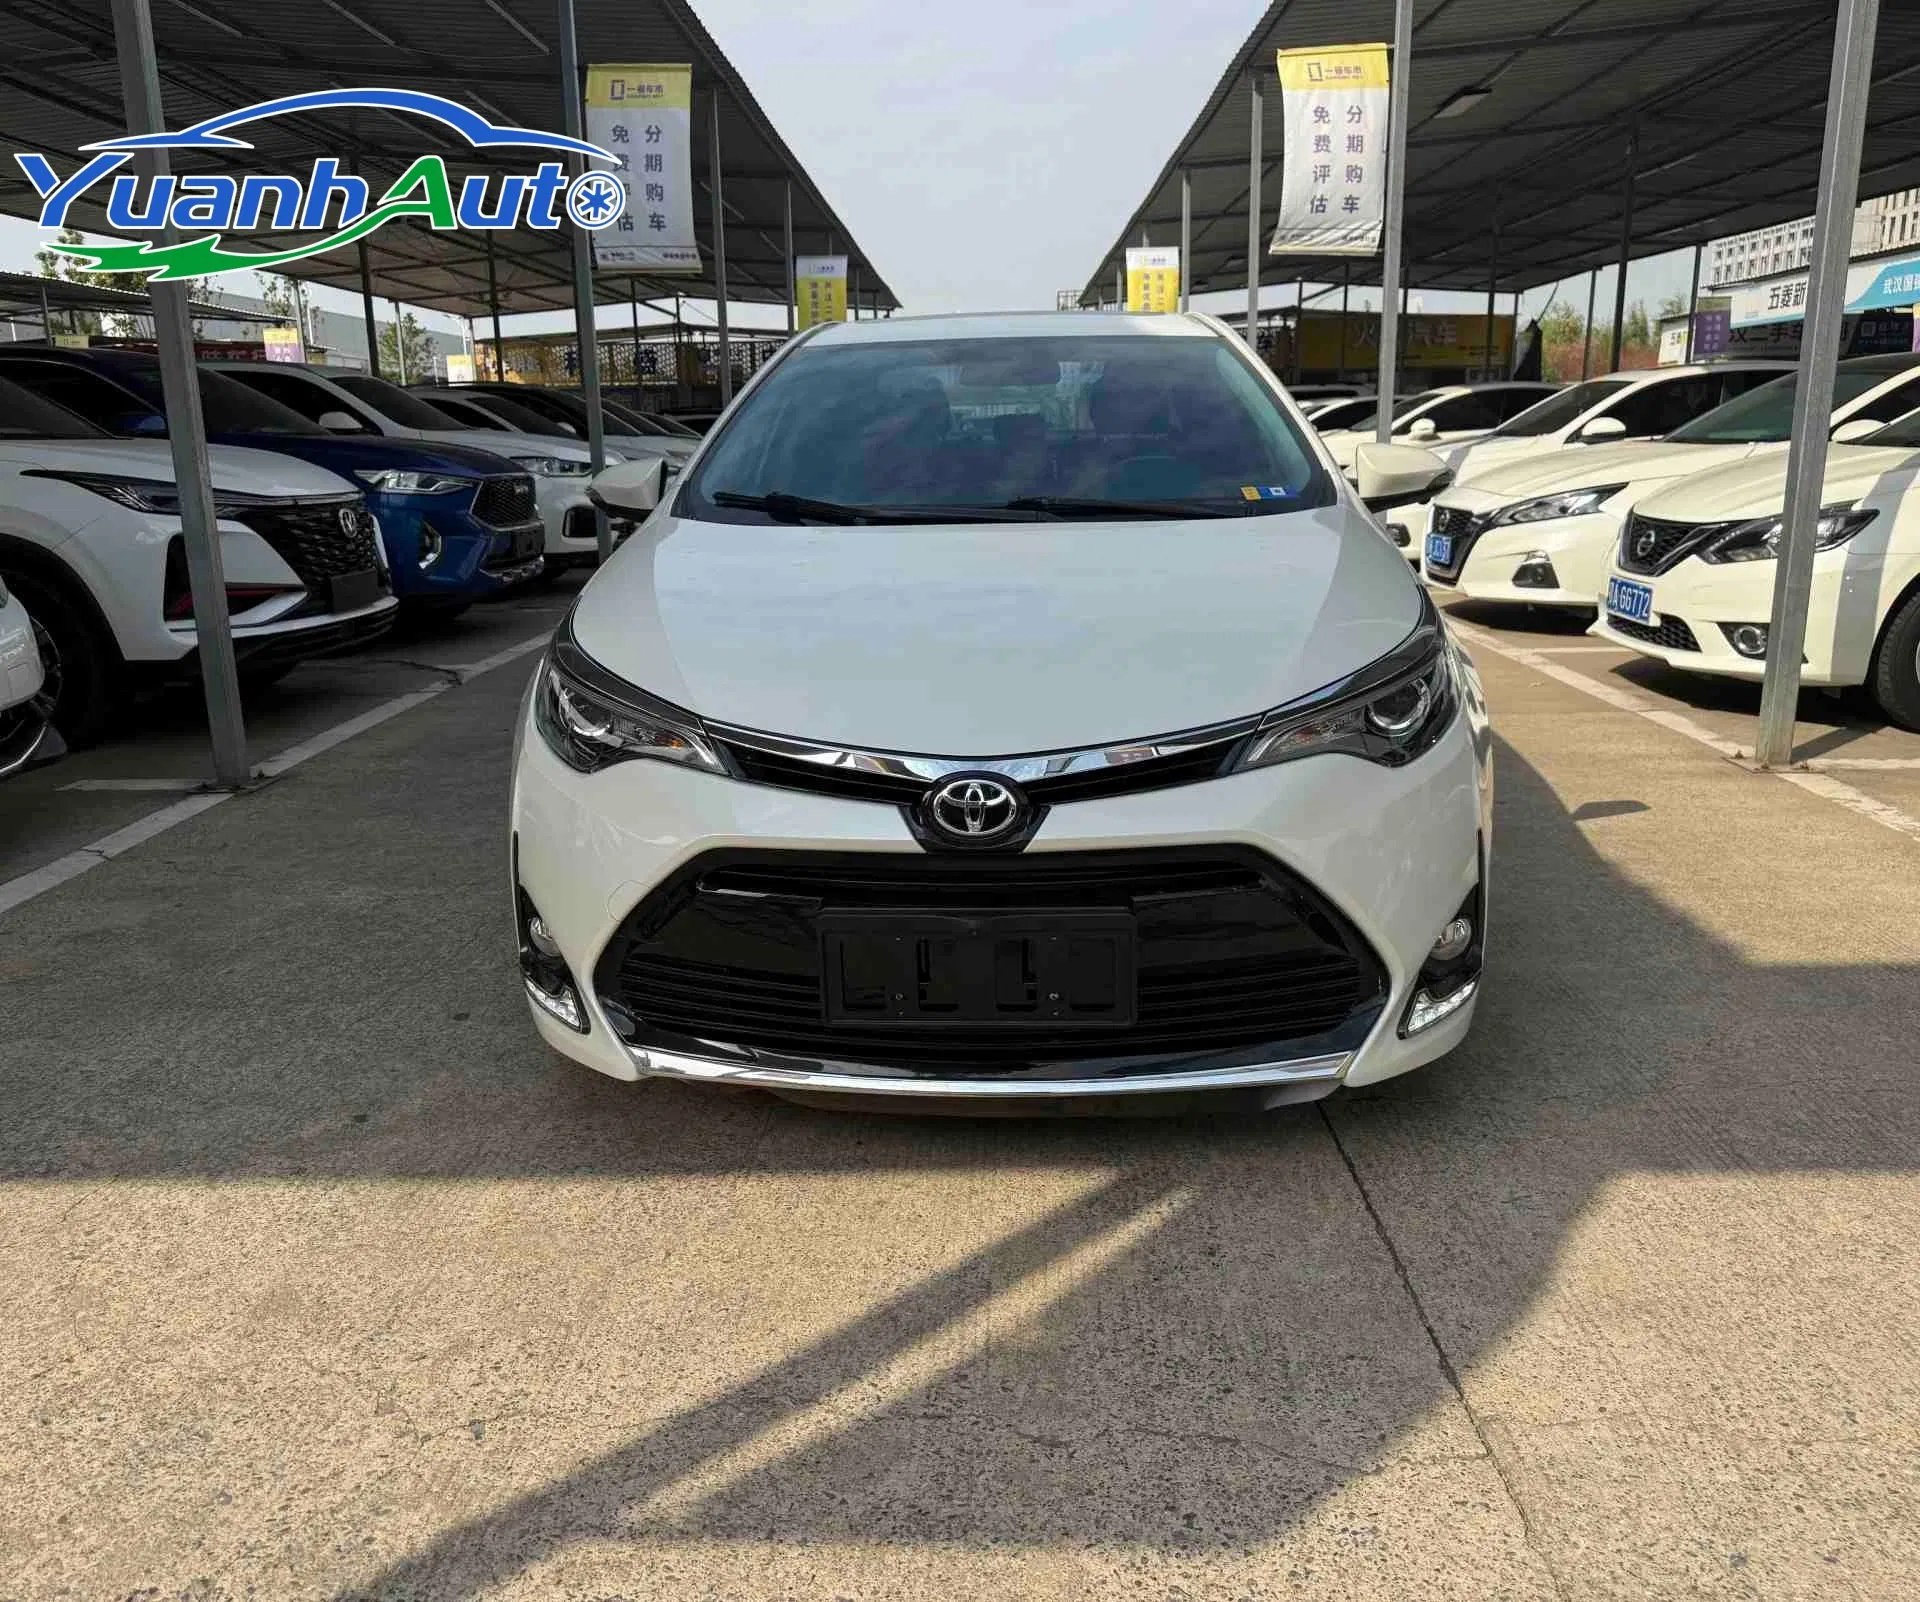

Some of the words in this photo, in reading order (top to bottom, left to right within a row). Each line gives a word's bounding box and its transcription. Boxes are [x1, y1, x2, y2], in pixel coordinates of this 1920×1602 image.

[644, 124, 666, 232] 分期购车
[1309, 105, 1331, 214] 免费评估
[1341, 105, 1364, 214] 分期购车
[1768, 280, 1807, 310] 五菱新
